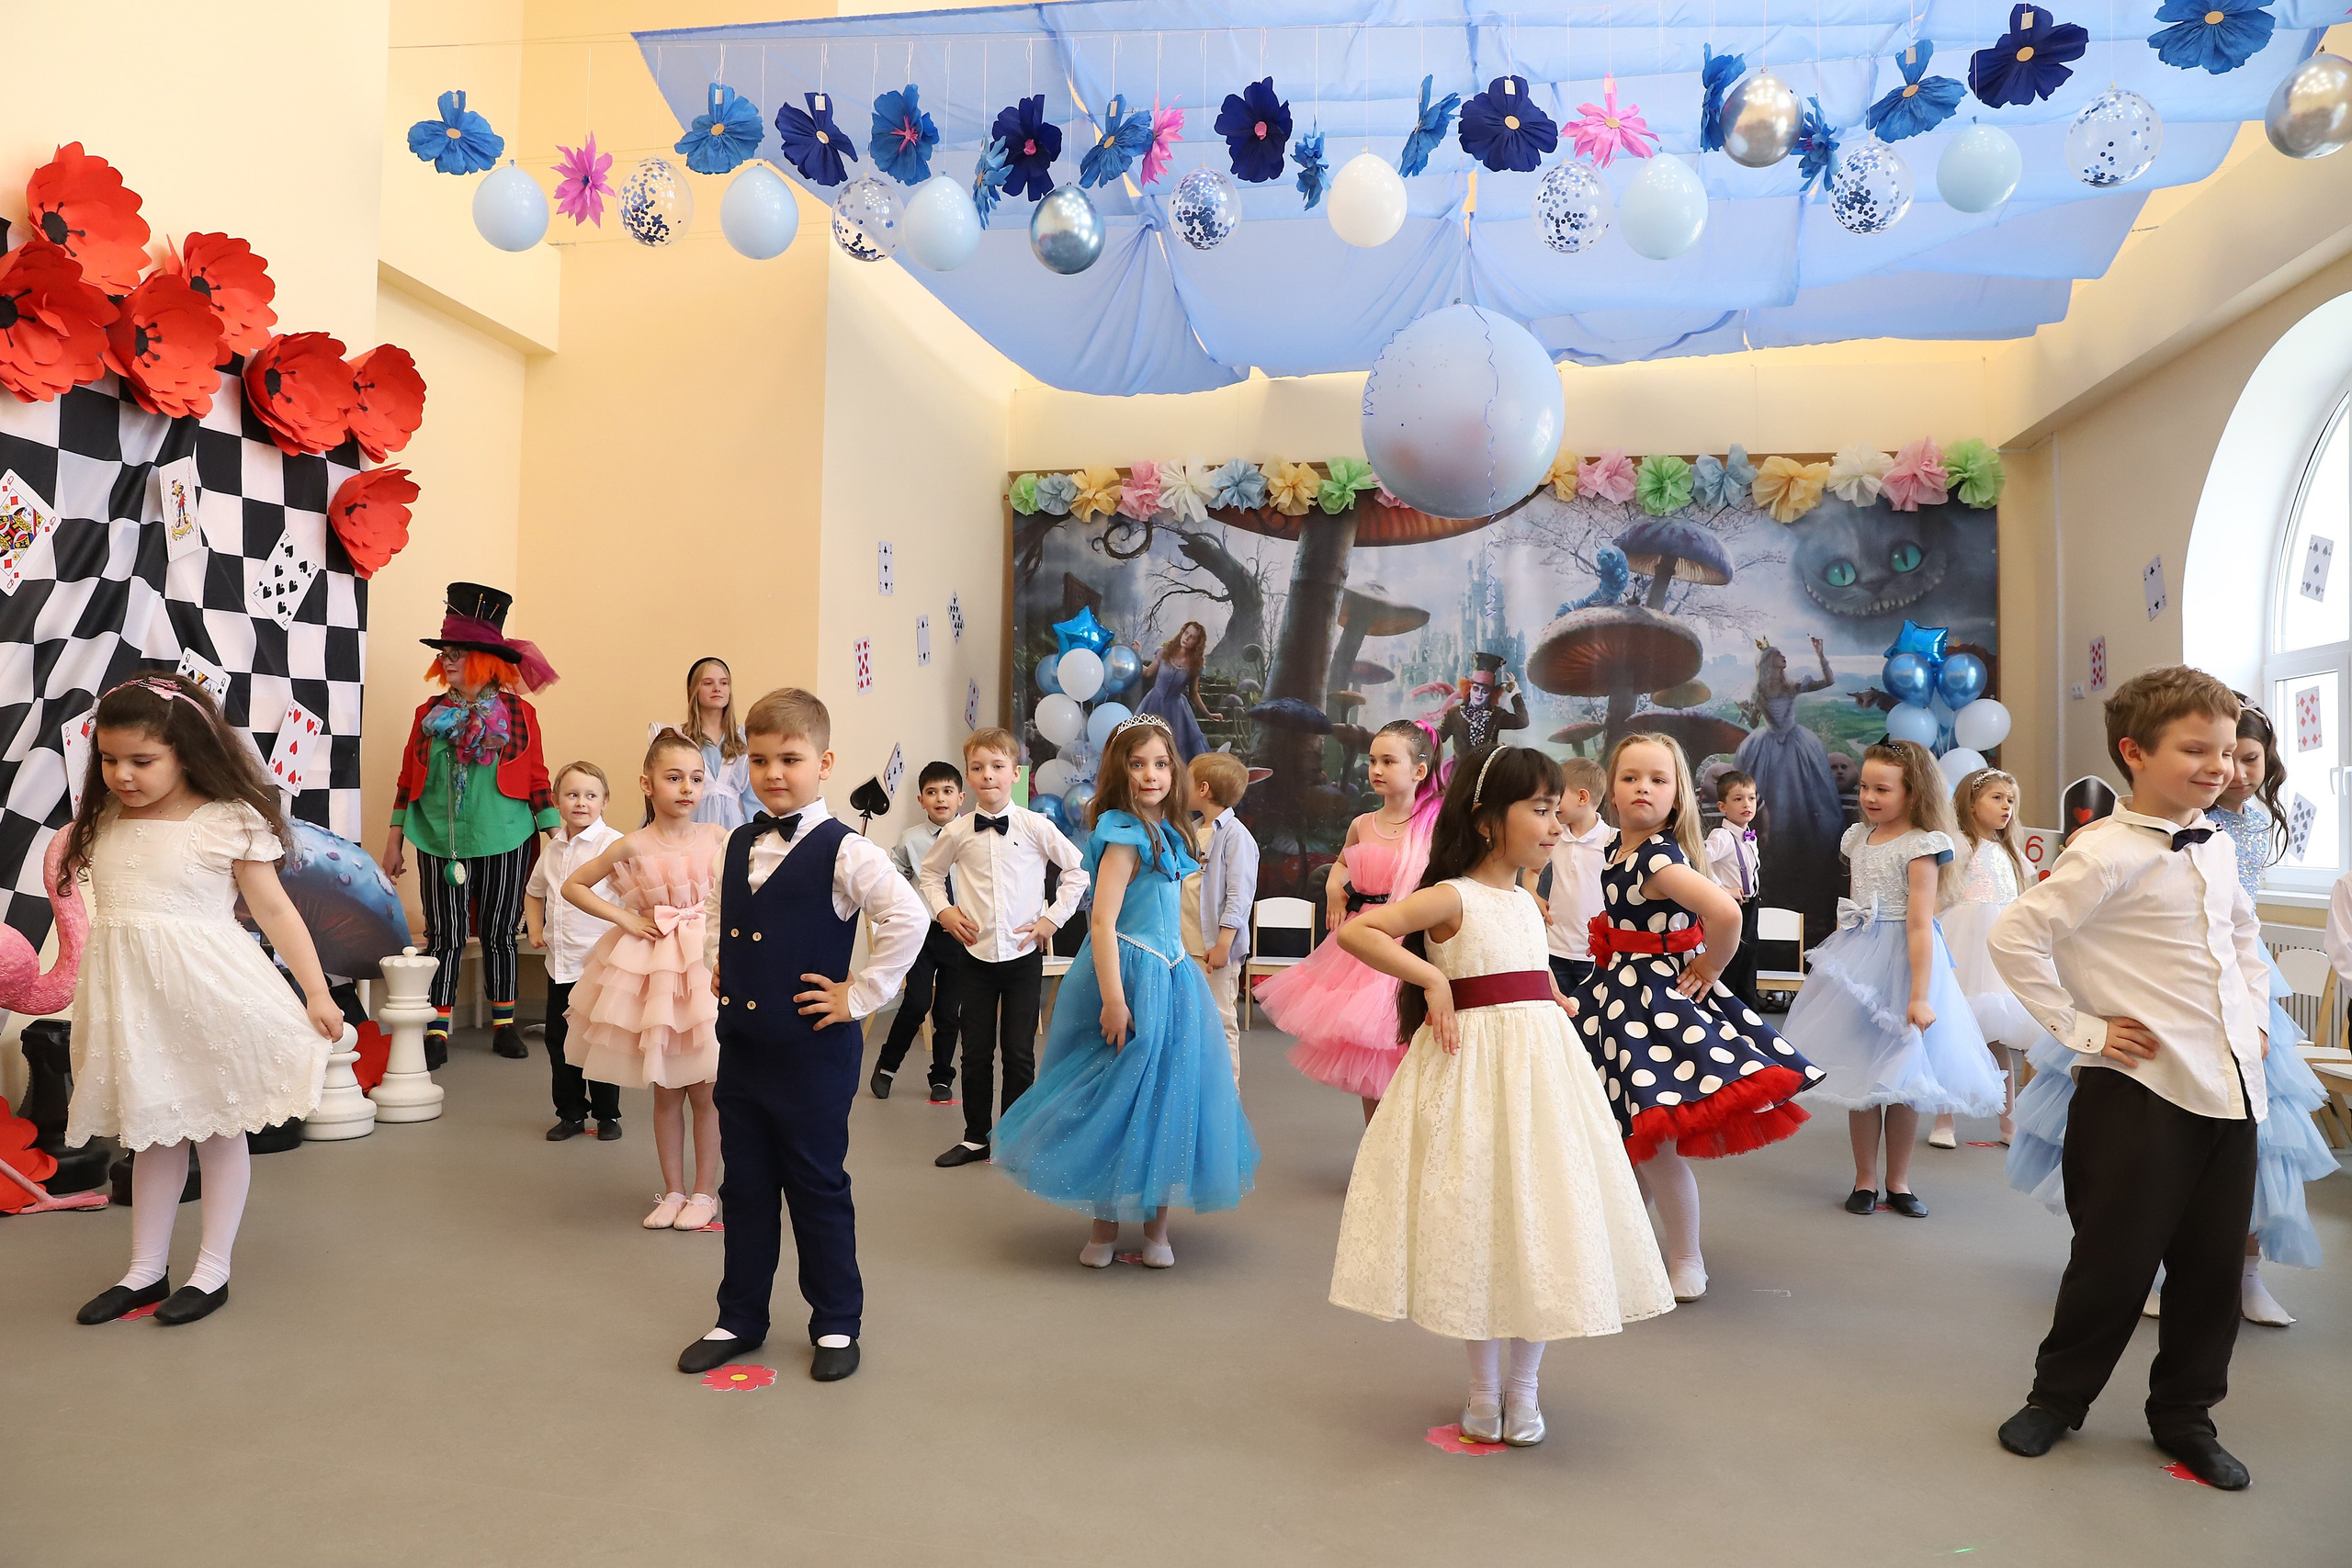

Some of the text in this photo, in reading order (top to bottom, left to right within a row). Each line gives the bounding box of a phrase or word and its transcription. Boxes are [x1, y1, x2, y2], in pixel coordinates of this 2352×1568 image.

[7, 476, 14, 486] Q
[50, 516, 56, 526] Q
[284, 533, 289, 541] 7
[7, 579, 14, 589] Q
[186, 654, 190, 663] Q
[220, 678, 226, 687] Q
[290, 702, 295, 711] 5
[315, 720, 321, 729] 5
[64, 727, 70, 738] 2
[2025, 835, 2044, 863] 6
